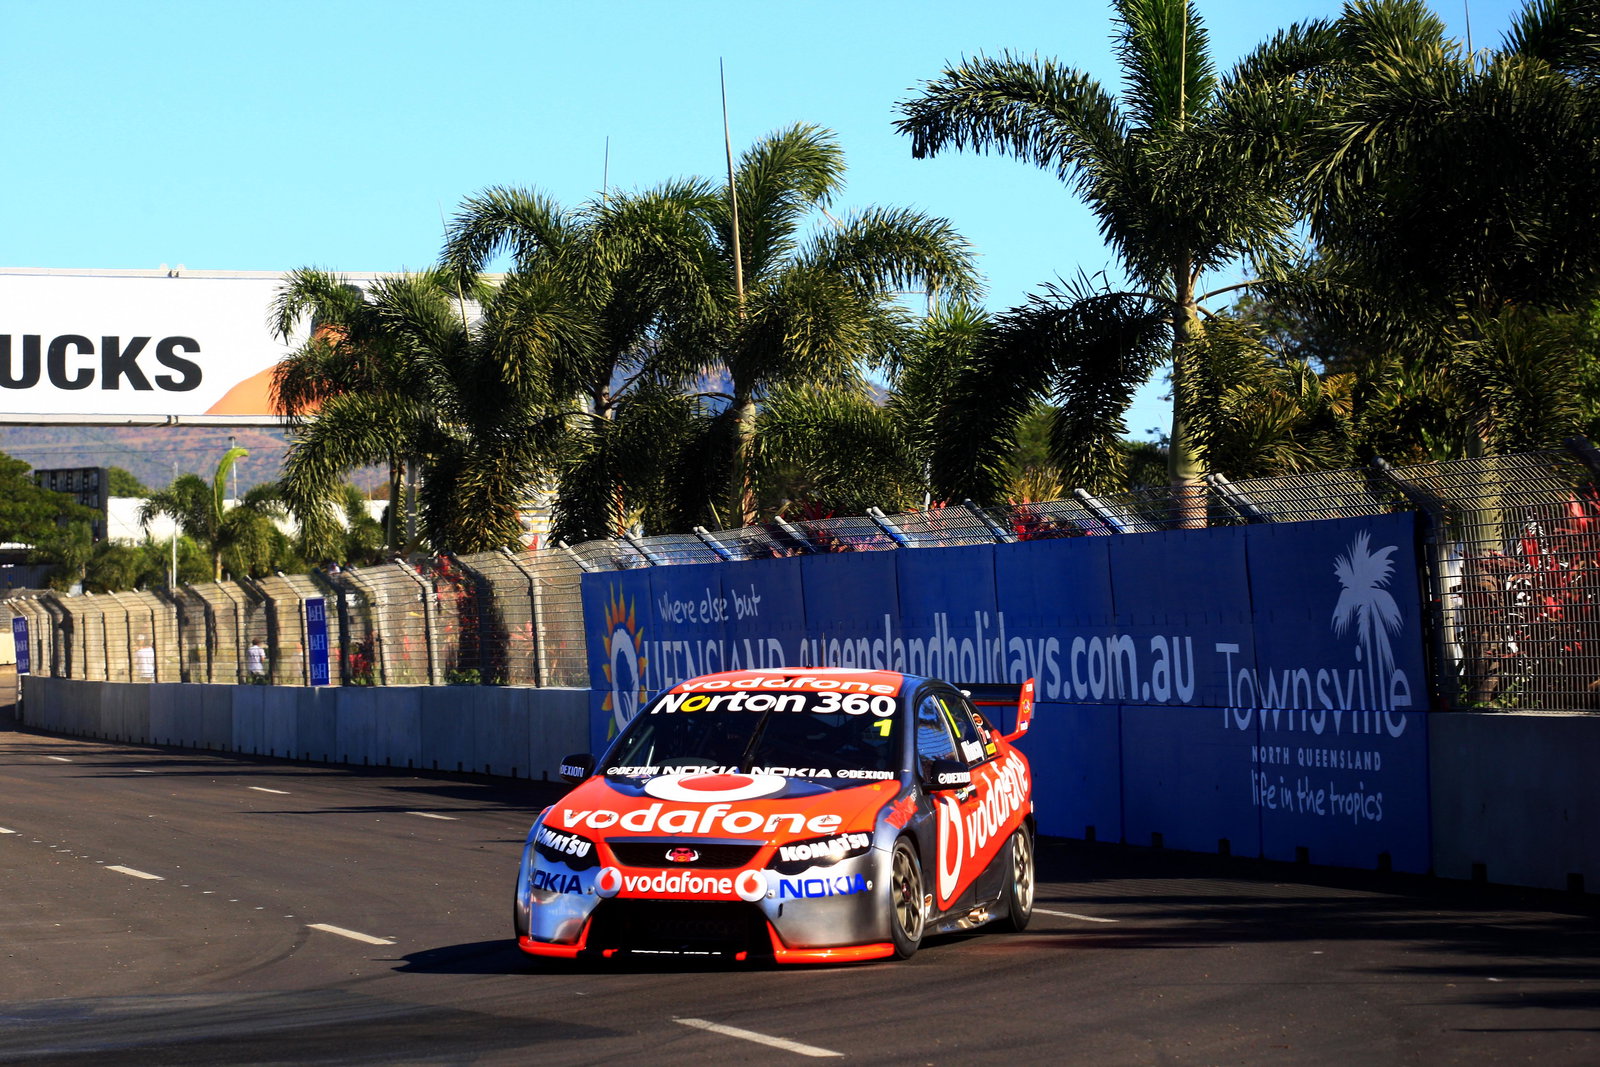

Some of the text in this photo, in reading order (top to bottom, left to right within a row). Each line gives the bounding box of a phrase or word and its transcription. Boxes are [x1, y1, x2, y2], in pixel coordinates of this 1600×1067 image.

[0, 334, 202, 392] UCKS
[700, 587, 728, 623] else
[732, 583, 761, 619] but
[681, 677, 895, 694] vodafone
[1216, 642, 1412, 738] Townsville
[650, 691, 897, 718] Norton 360
[873, 719, 893, 737] 1
[1251, 746, 1382, 772] NORTH QUEENSLAND
[617, 766, 661, 776] DEXION
[750, 766, 833, 779] NOKIA
[848, 770, 895, 781] DEXION
[1251, 769, 1384, 826] life in the tropics
[563, 803, 843, 835] vodafone
[538, 826, 592, 858] OMATSU
[779, 832, 870, 862] KOMATSU
[531, 868, 583, 895] OKIA
[624, 870, 732, 894] vodafone
[779, 872, 868, 899] NOKIA
